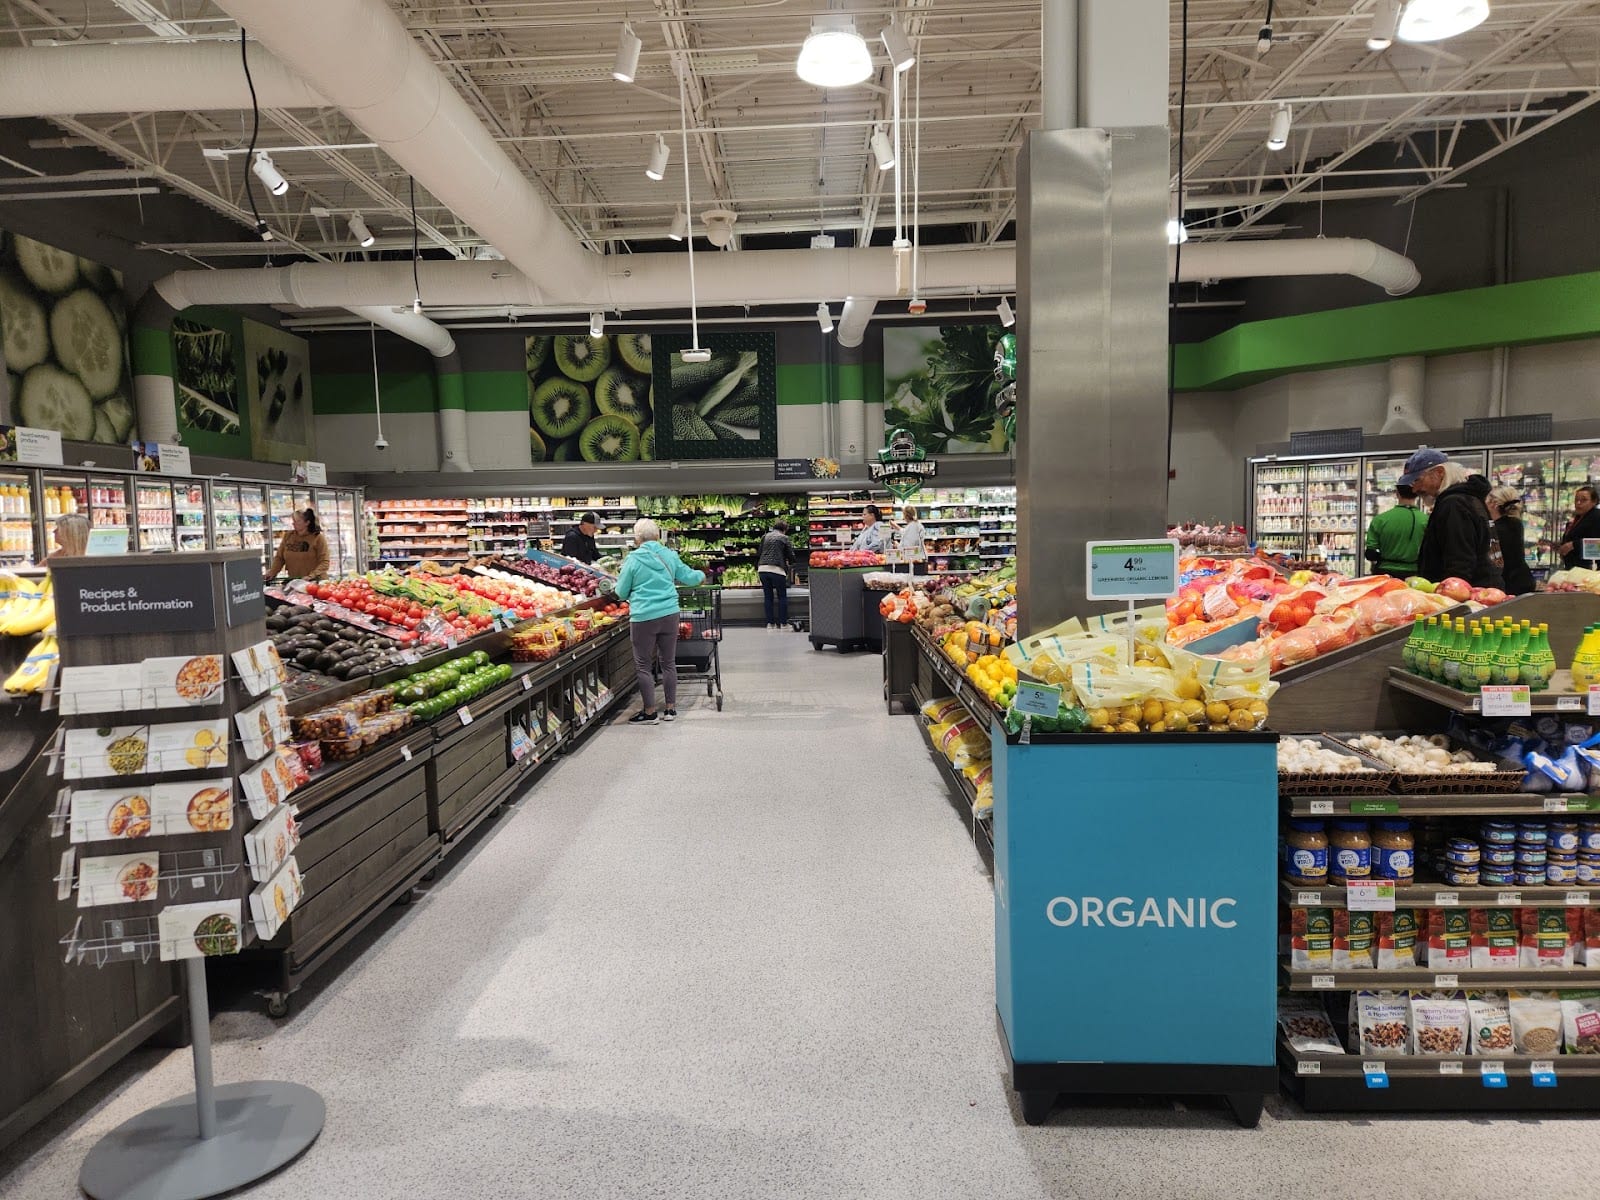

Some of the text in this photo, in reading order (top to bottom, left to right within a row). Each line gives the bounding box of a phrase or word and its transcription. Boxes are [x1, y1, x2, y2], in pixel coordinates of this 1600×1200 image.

[868, 461, 936, 478] PARTY ZONE
[1124, 557, 1134, 572] 4
[79, 587, 138, 601] Recipes &
[80, 598, 194, 613] Product Information
[1034, 691, 1040, 699] 5
[1046, 896, 1238, 929] ORGANIC
